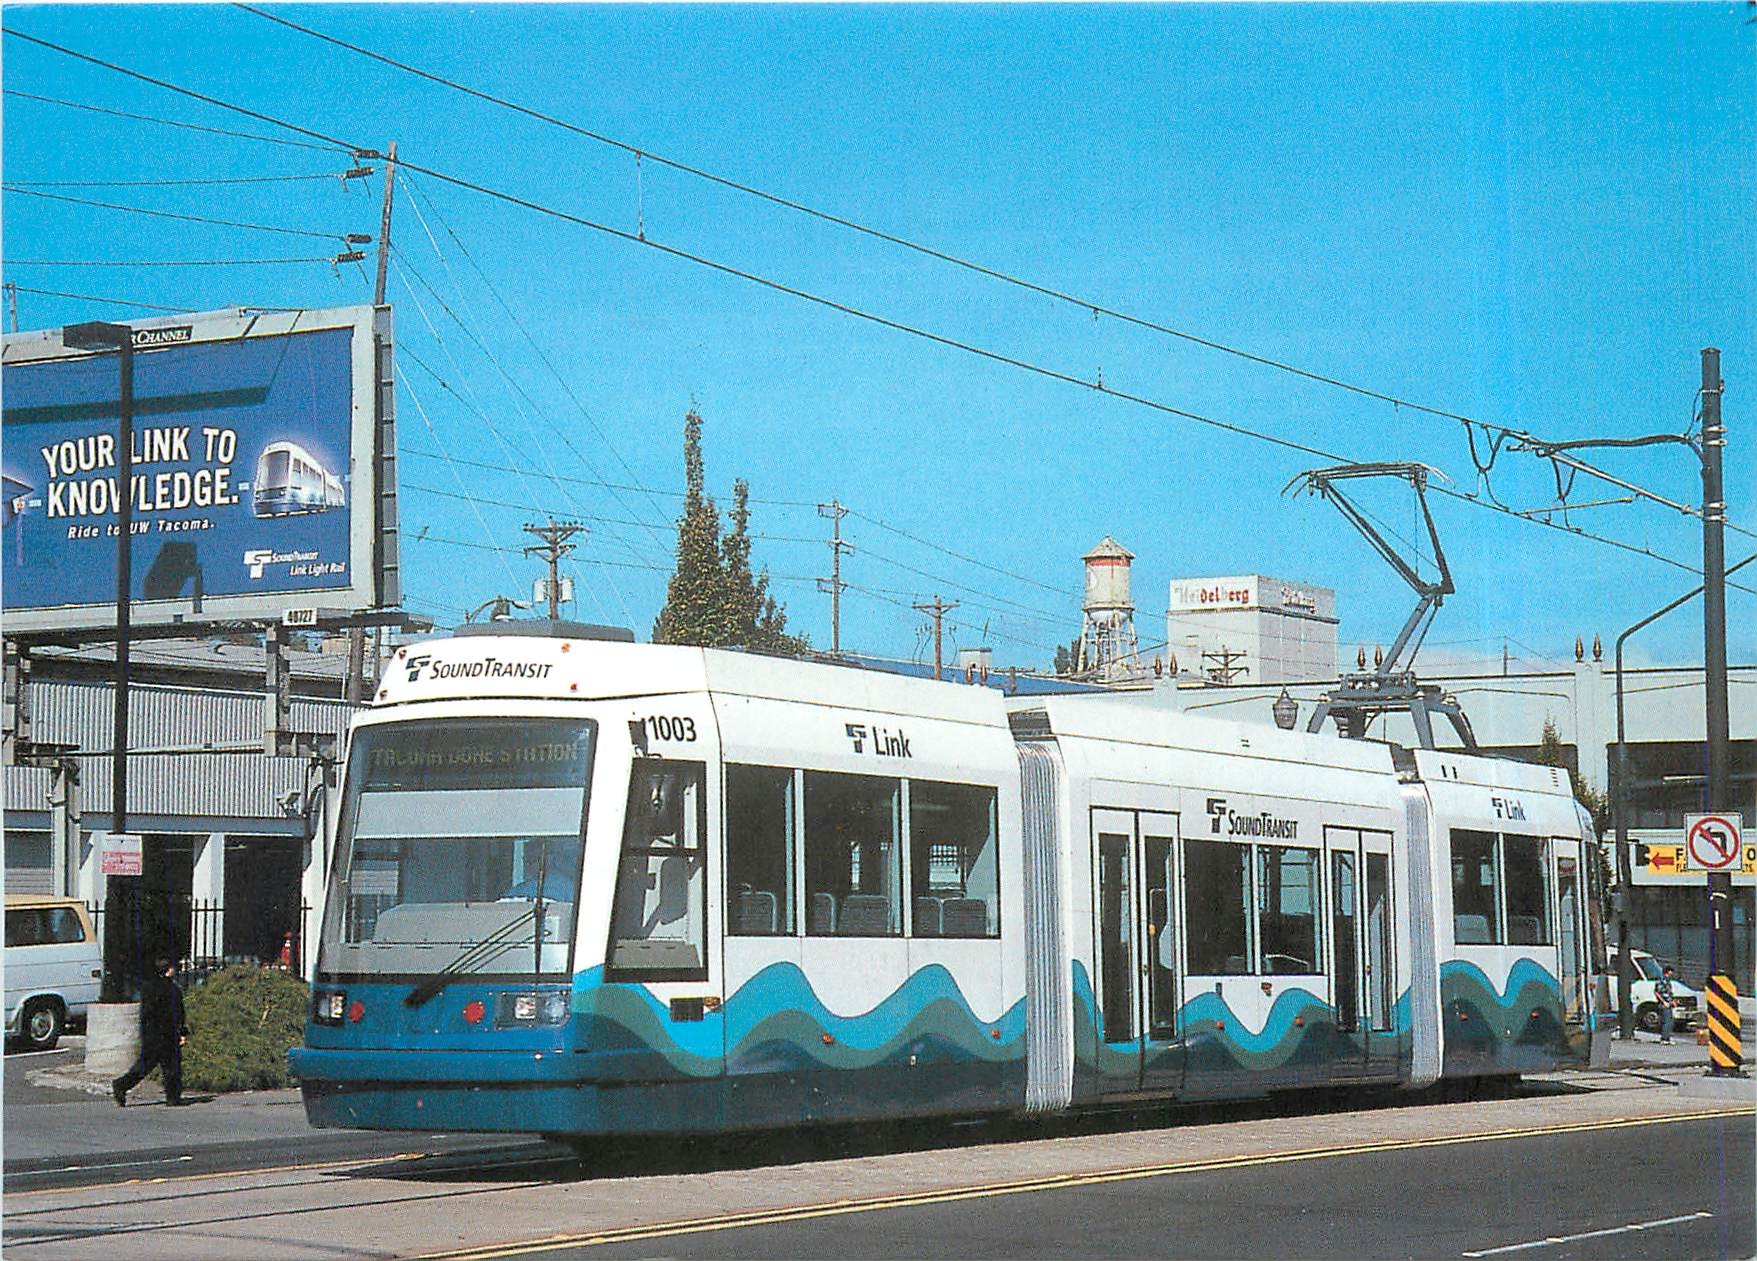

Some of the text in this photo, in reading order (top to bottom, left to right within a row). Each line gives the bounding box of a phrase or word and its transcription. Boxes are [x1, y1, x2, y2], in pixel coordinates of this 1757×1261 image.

[41, 427, 236, 479] YOUR LINK TO
[48, 467, 239, 518] KNOWLEDGE.
[68, 518, 215, 539] Ride to UW Tacoma.
[648, 715, 697, 742] 1003
[872, 725, 912, 758] Link
[1503, 799, 1526, 821] Link
